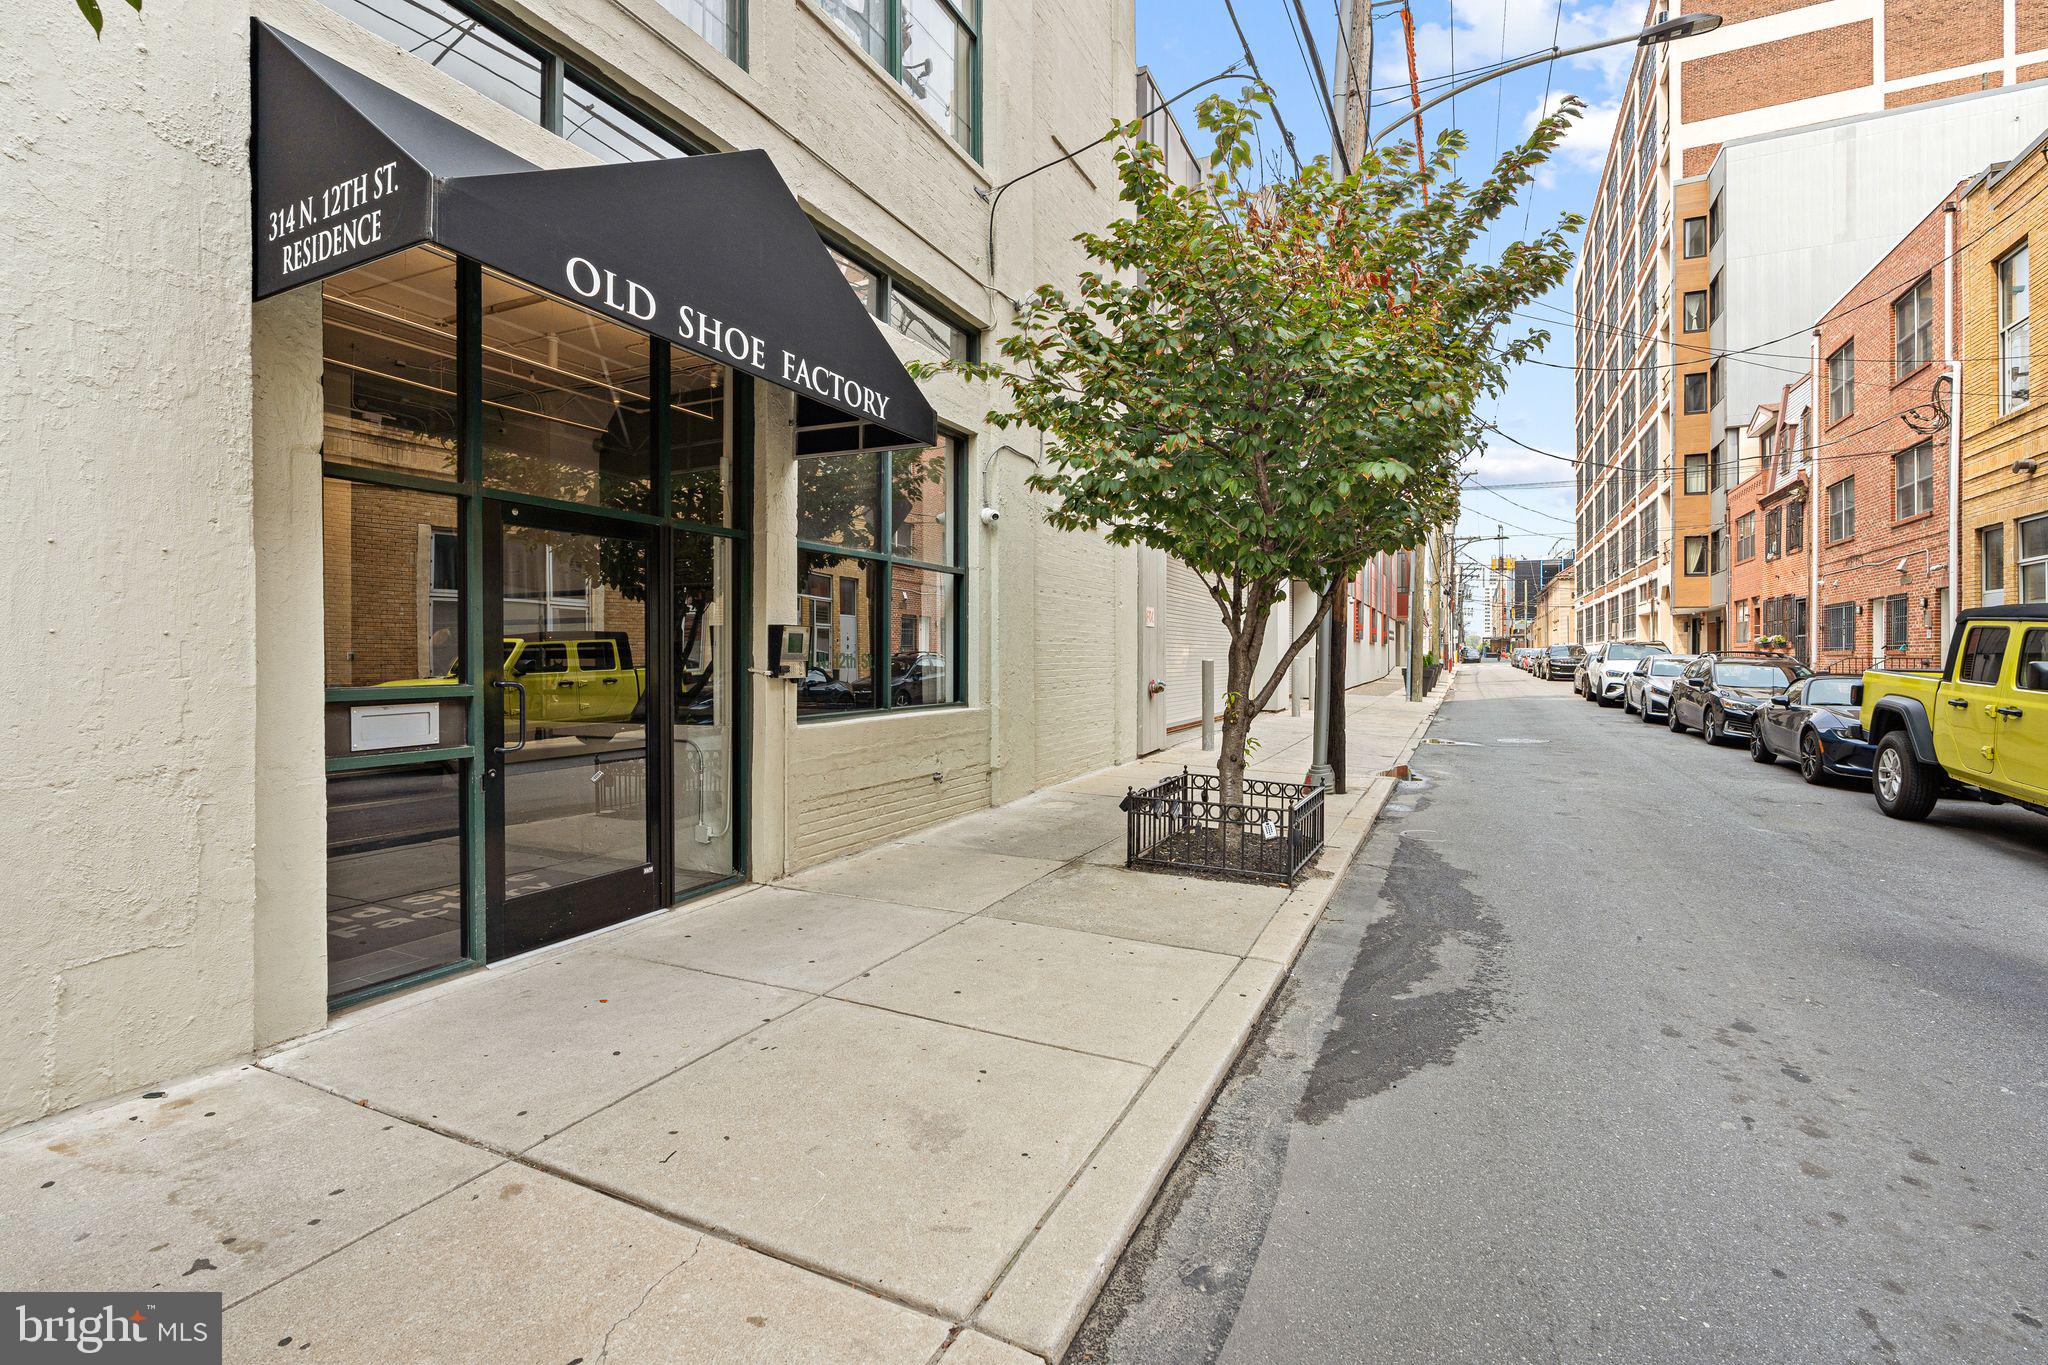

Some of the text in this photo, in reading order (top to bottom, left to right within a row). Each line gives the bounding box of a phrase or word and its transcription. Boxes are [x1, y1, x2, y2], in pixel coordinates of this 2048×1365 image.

[268, 161, 399, 242] 314 N. 12TH ST.
[281, 211, 382, 275] RESIDENCE
[565, 256, 891, 420] OLD SHOE FACTORY
